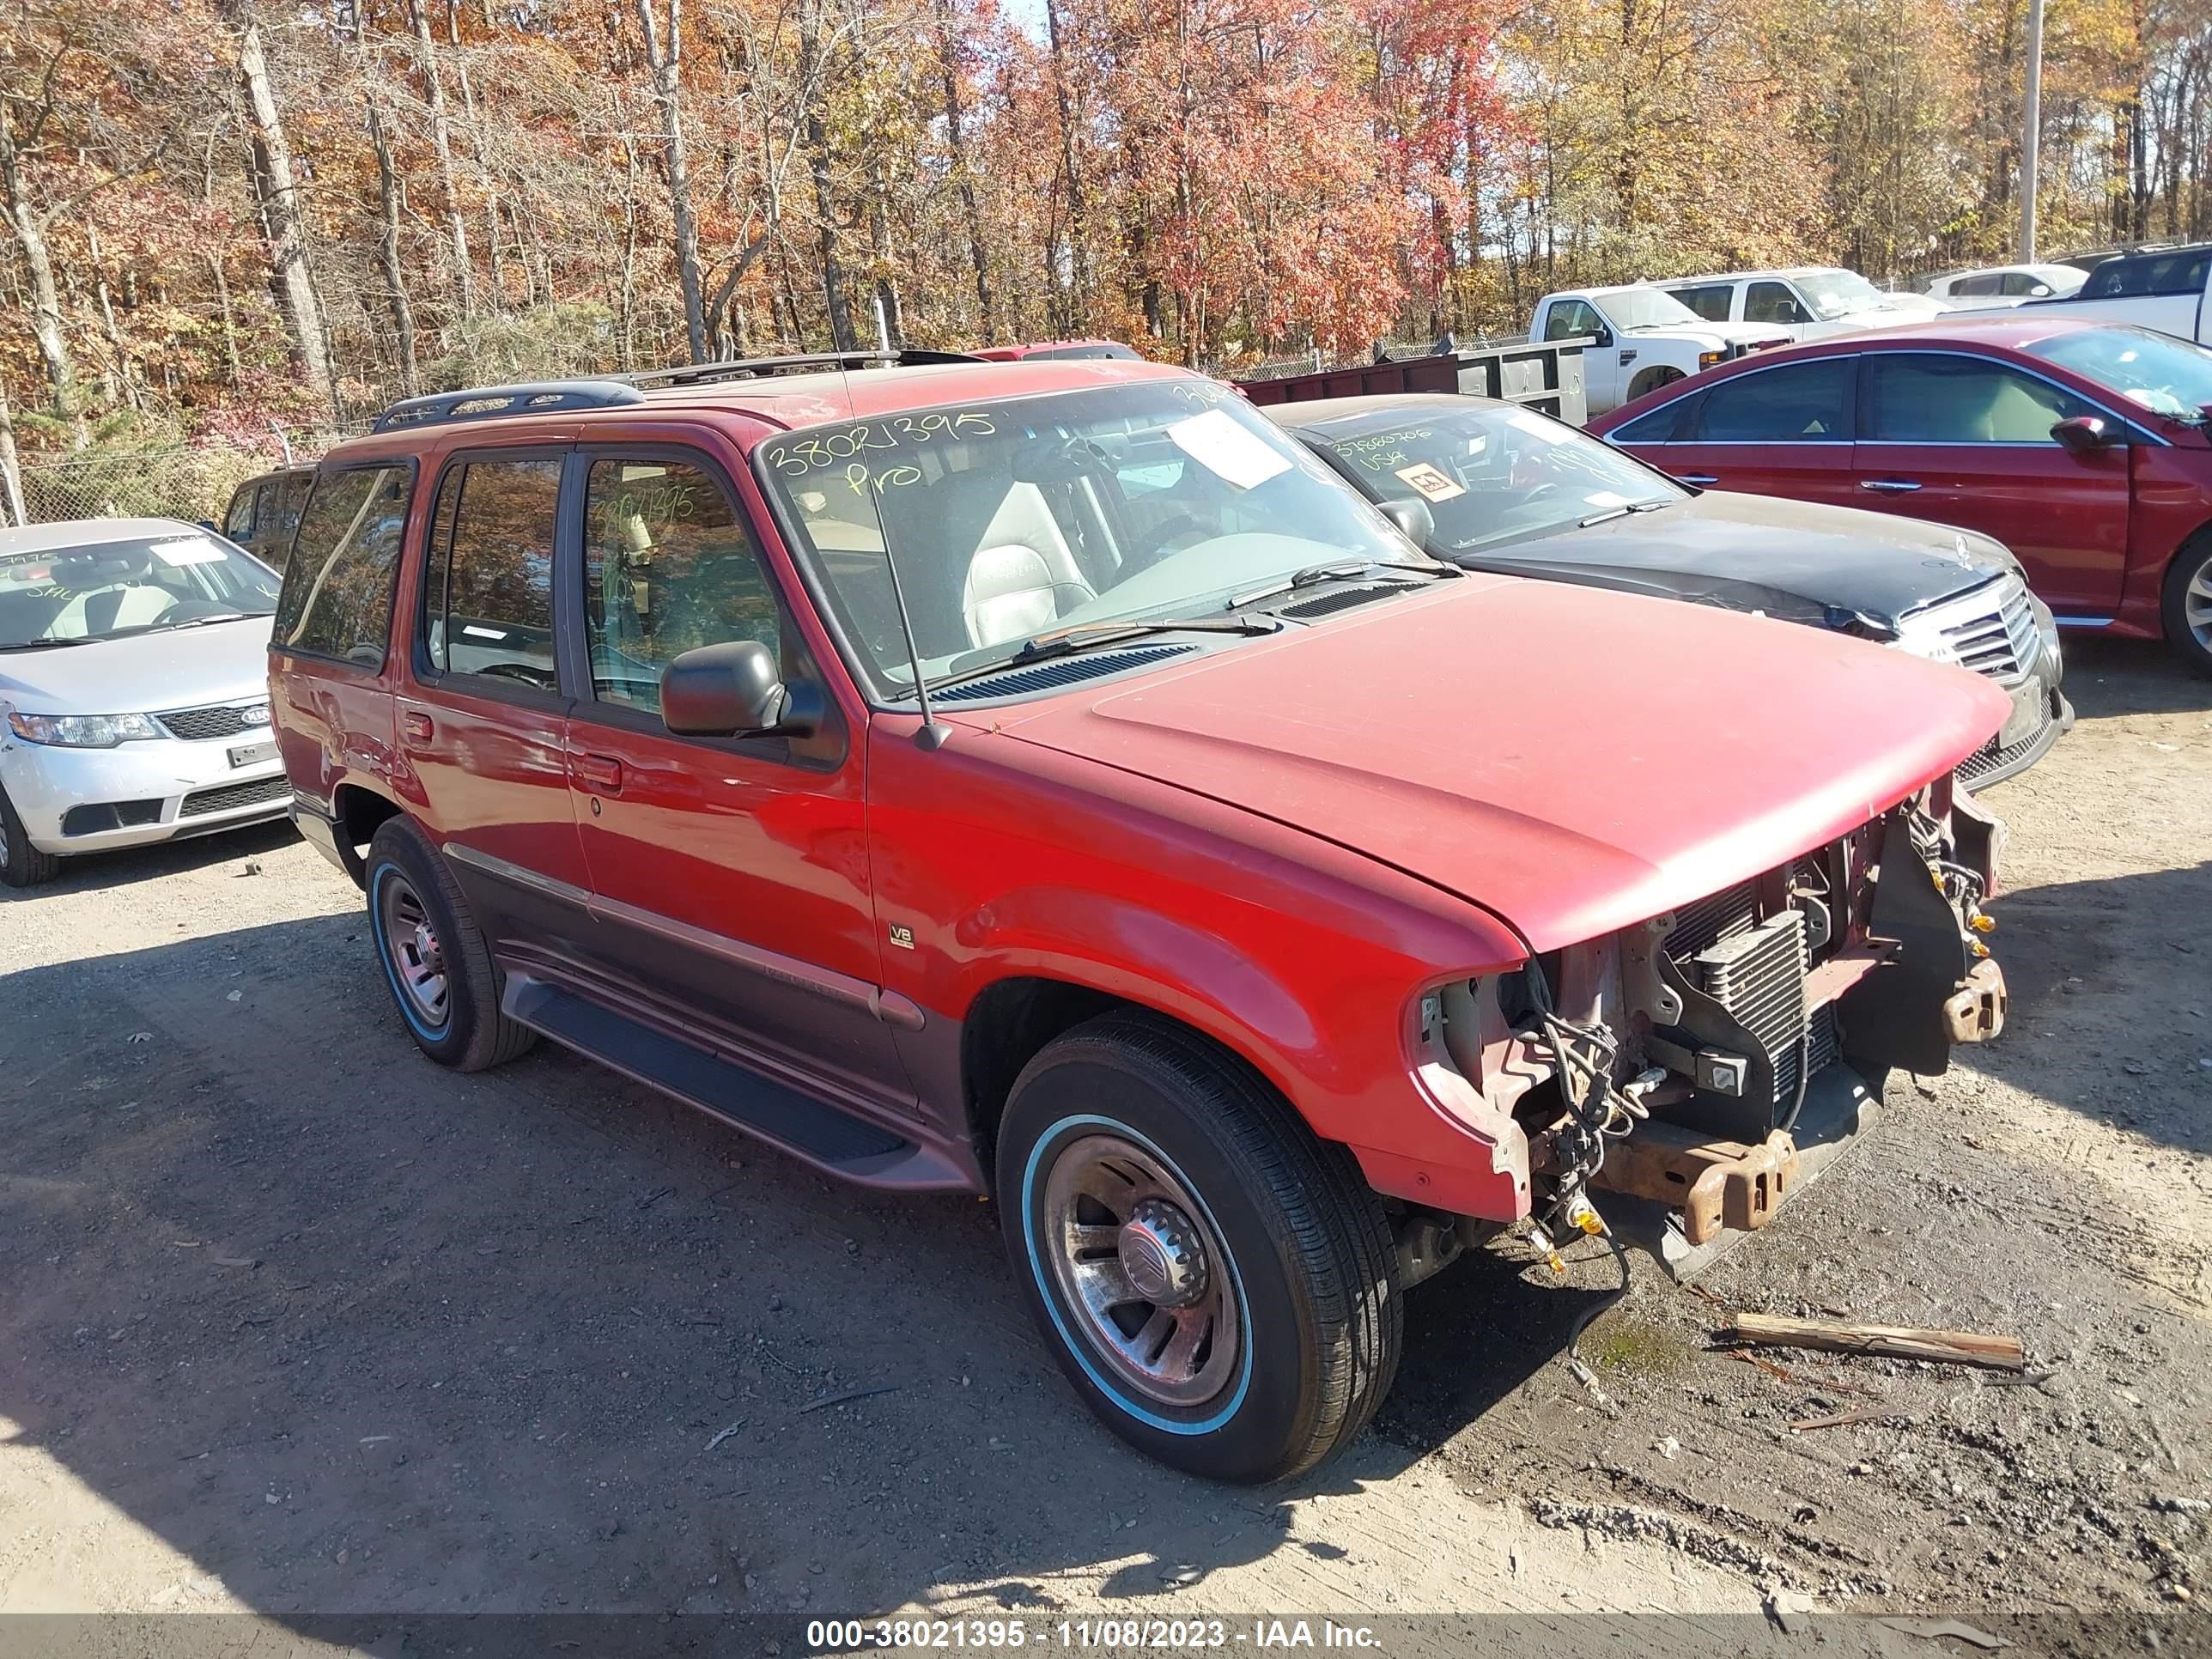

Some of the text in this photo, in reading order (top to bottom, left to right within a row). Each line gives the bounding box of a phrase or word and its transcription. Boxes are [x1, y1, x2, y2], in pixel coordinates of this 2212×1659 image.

[769, 413, 996, 476] 38021395
[845, 463, 921, 496] Pro
[891, 925, 912, 941] V8
